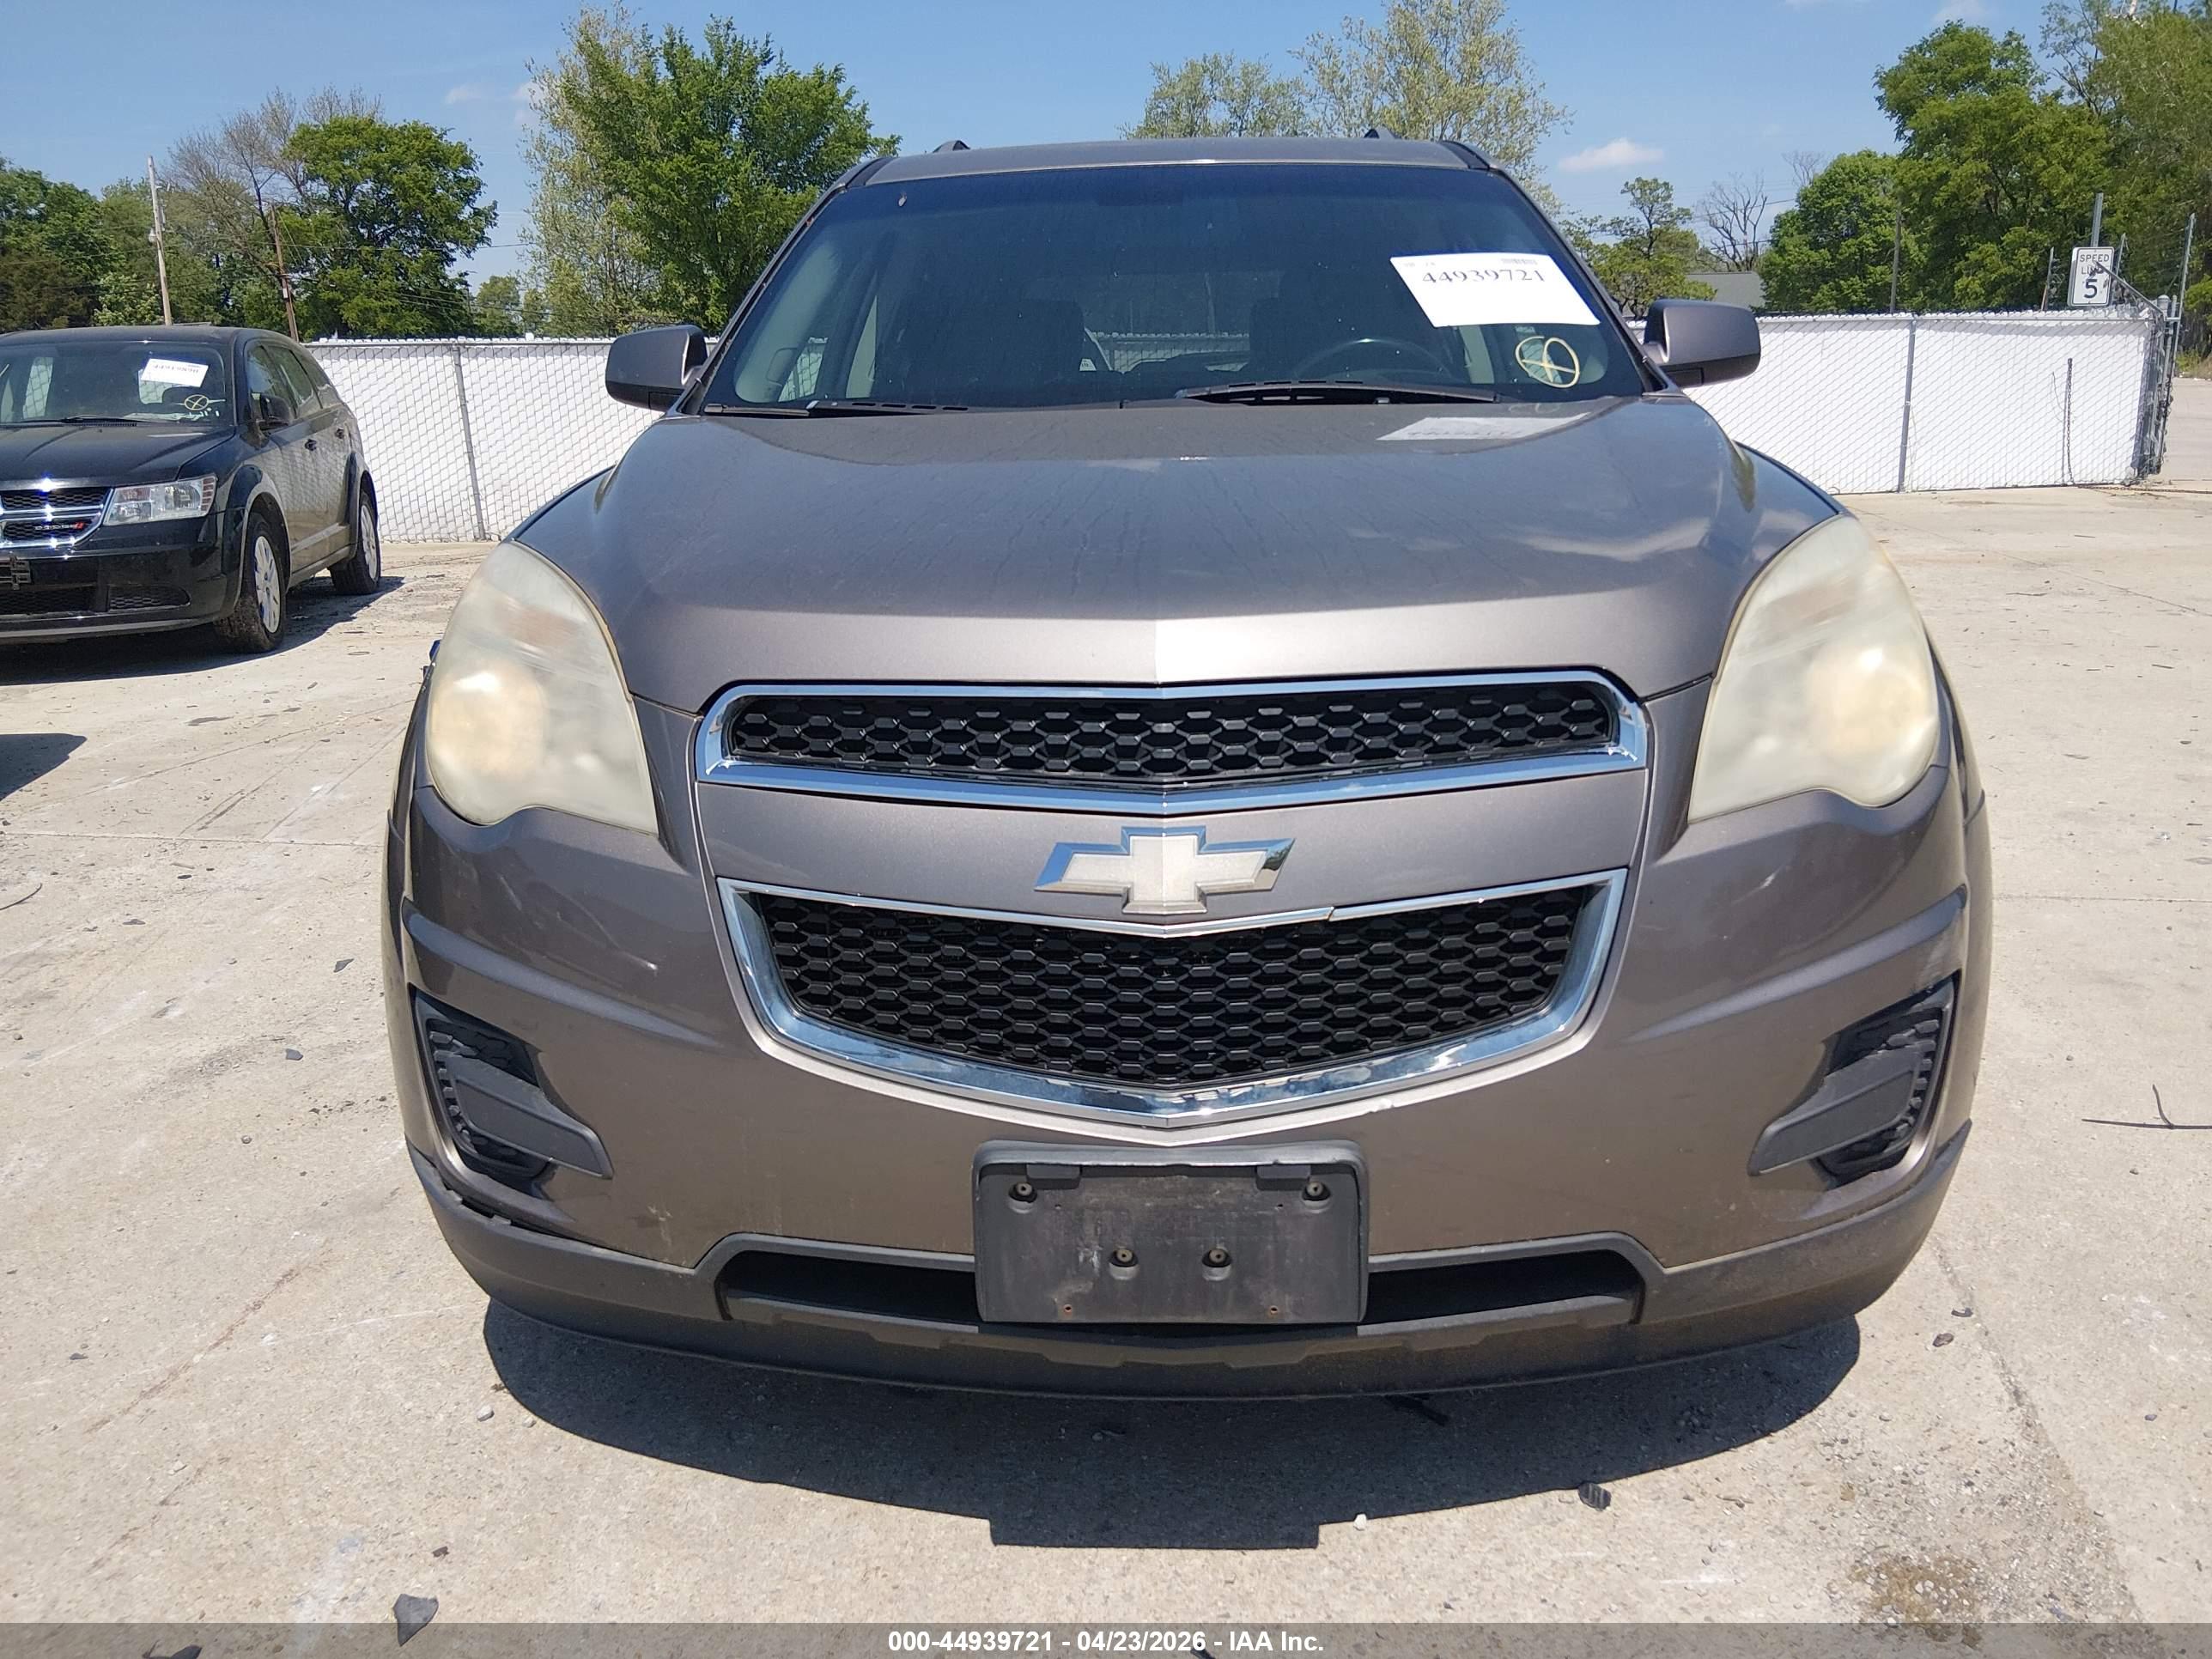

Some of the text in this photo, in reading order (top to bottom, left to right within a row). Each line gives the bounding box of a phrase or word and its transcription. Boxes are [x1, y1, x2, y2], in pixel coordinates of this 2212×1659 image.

[2079, 254, 2110, 263] SPEED
[1422, 269, 1545, 283] 44939721
[2083, 278, 2098, 299] 5
